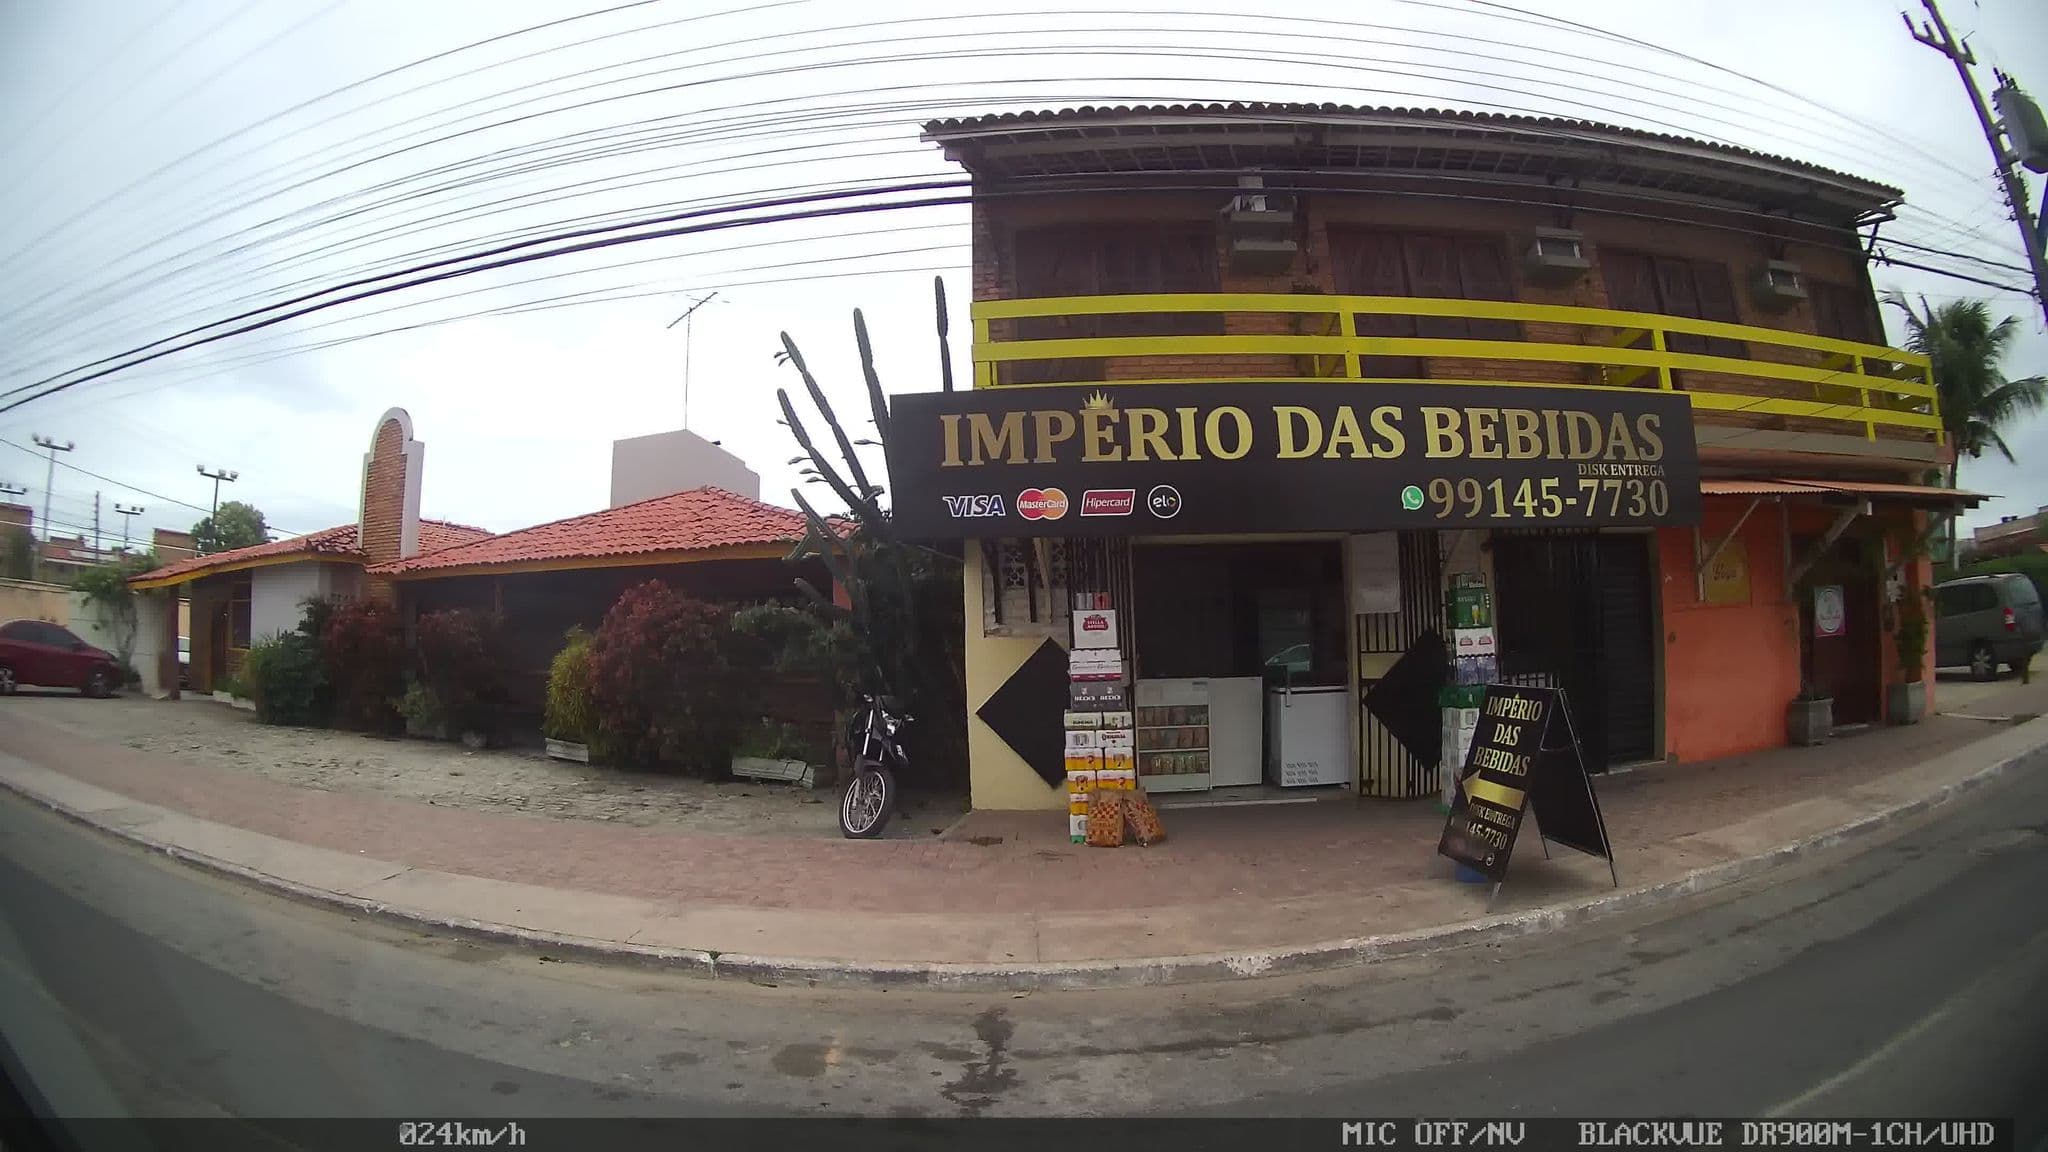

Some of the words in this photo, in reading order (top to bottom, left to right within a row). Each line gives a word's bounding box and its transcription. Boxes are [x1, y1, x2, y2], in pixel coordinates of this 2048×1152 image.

[1273, 405, 1407, 460] DAS
[1420, 406, 1665, 462] BEBIDAS
[1578, 463, 1609, 476] DISK
[1610, 464, 1665, 477] ENTREGA
[942, 494, 1007, 518] VISA
[1019, 499, 1066, 509] MasterCard
[1086, 497, 1130, 509] Hipercard
[1152, 494, 1177, 508] elo
[1428, 477, 1669, 518] 99145-7730
[1493, 723, 1522, 746] DAS
[1473, 746, 1531, 777] BEBIDAS
